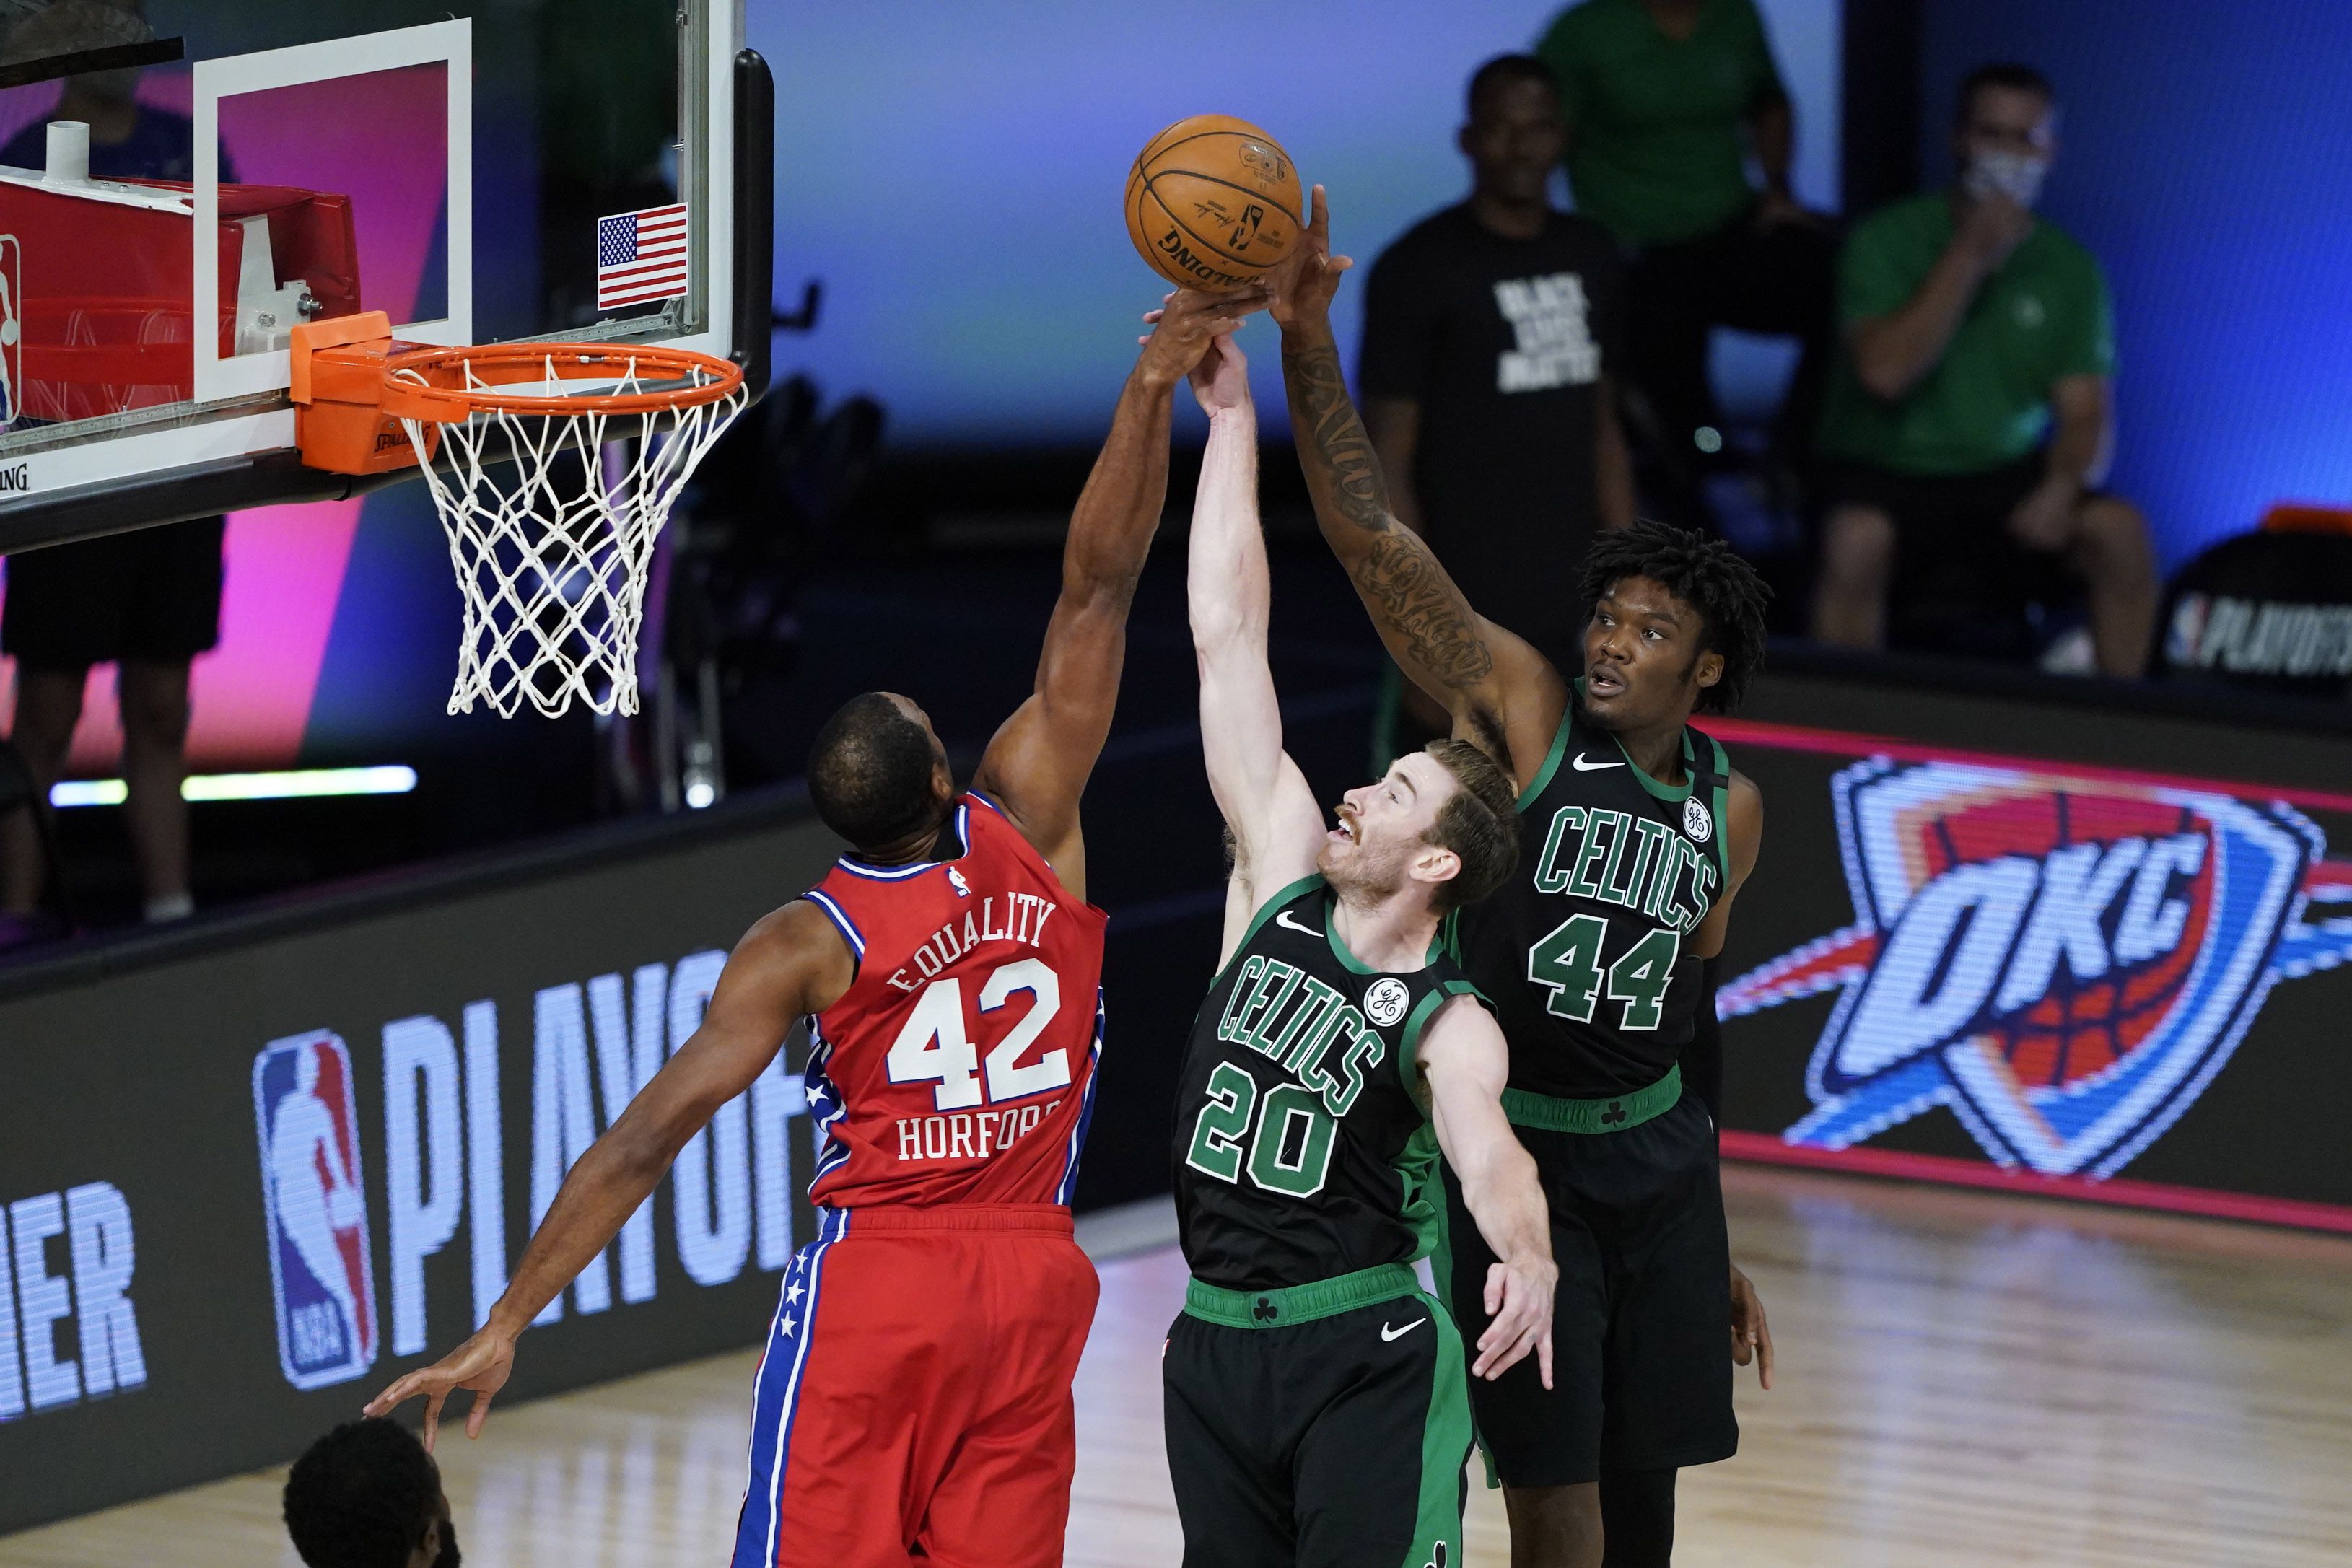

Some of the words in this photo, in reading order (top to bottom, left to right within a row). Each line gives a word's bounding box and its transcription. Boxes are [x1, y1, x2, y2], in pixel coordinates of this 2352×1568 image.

[887, 892, 1057, 993] EQUALITY
[1534, 805, 1718, 936] CELTICS
[1527, 913, 1681, 1030] 44
[1835, 831, 2208, 1076] OKC
[887, 958, 1072, 1111] 42
[1217, 955, 1386, 1117] CELTICS
[382, 947, 831, 1357] PLAYOF
[1186, 1060, 1338, 1198] 20
[0, 1180, 147, 1416] ER
